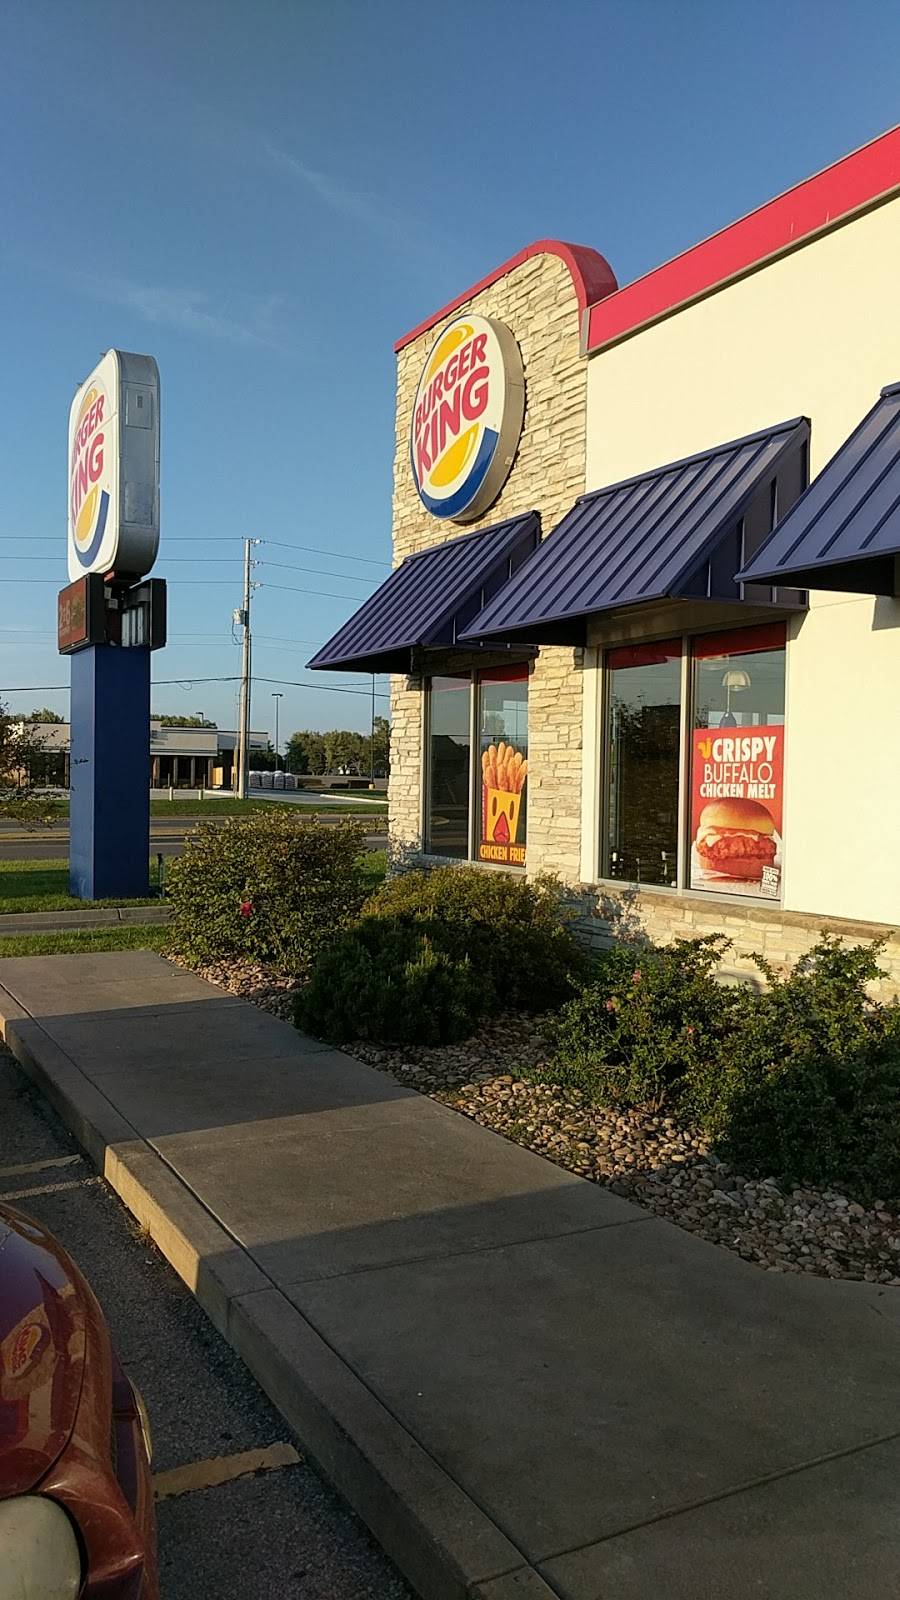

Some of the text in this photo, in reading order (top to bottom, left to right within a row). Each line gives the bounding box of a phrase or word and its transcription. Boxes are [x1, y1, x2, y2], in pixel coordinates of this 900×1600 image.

[415, 333, 488, 443] BURGER
[416, 366, 490, 490] KING
[712, 736, 777, 762] CRISPY
[704, 762, 773, 784] BUFFALO
[700, 783, 777, 799] CHICKEN MELT
[480, 844, 525, 862] CHICKEN FRIE
